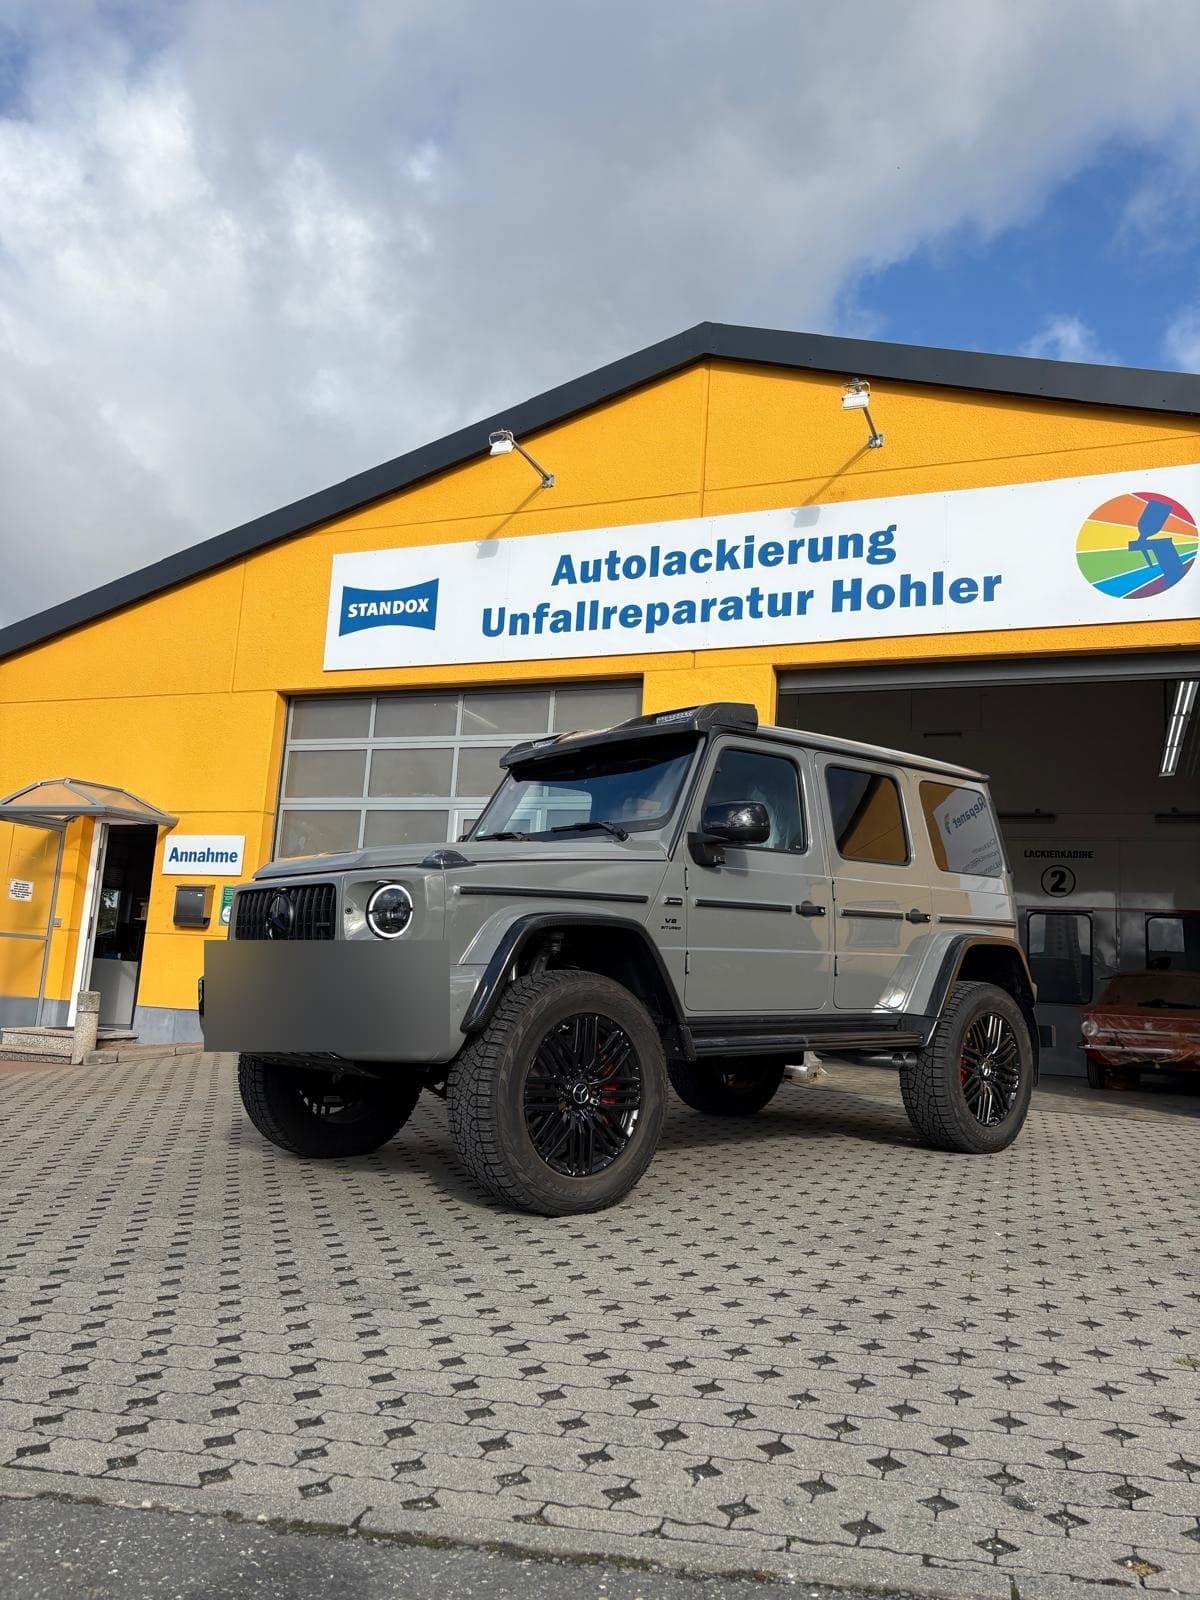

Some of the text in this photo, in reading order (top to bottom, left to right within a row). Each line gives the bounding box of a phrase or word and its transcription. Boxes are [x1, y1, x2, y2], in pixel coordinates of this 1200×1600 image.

[551, 525, 898, 587] Autolackierung
[347, 597, 430, 619] STANDOX
[482, 571, 1002, 638] Unfallreparatur Hohler
[168, 846, 239, 863] Annahme
[1050, 870, 1067, 893] 2
